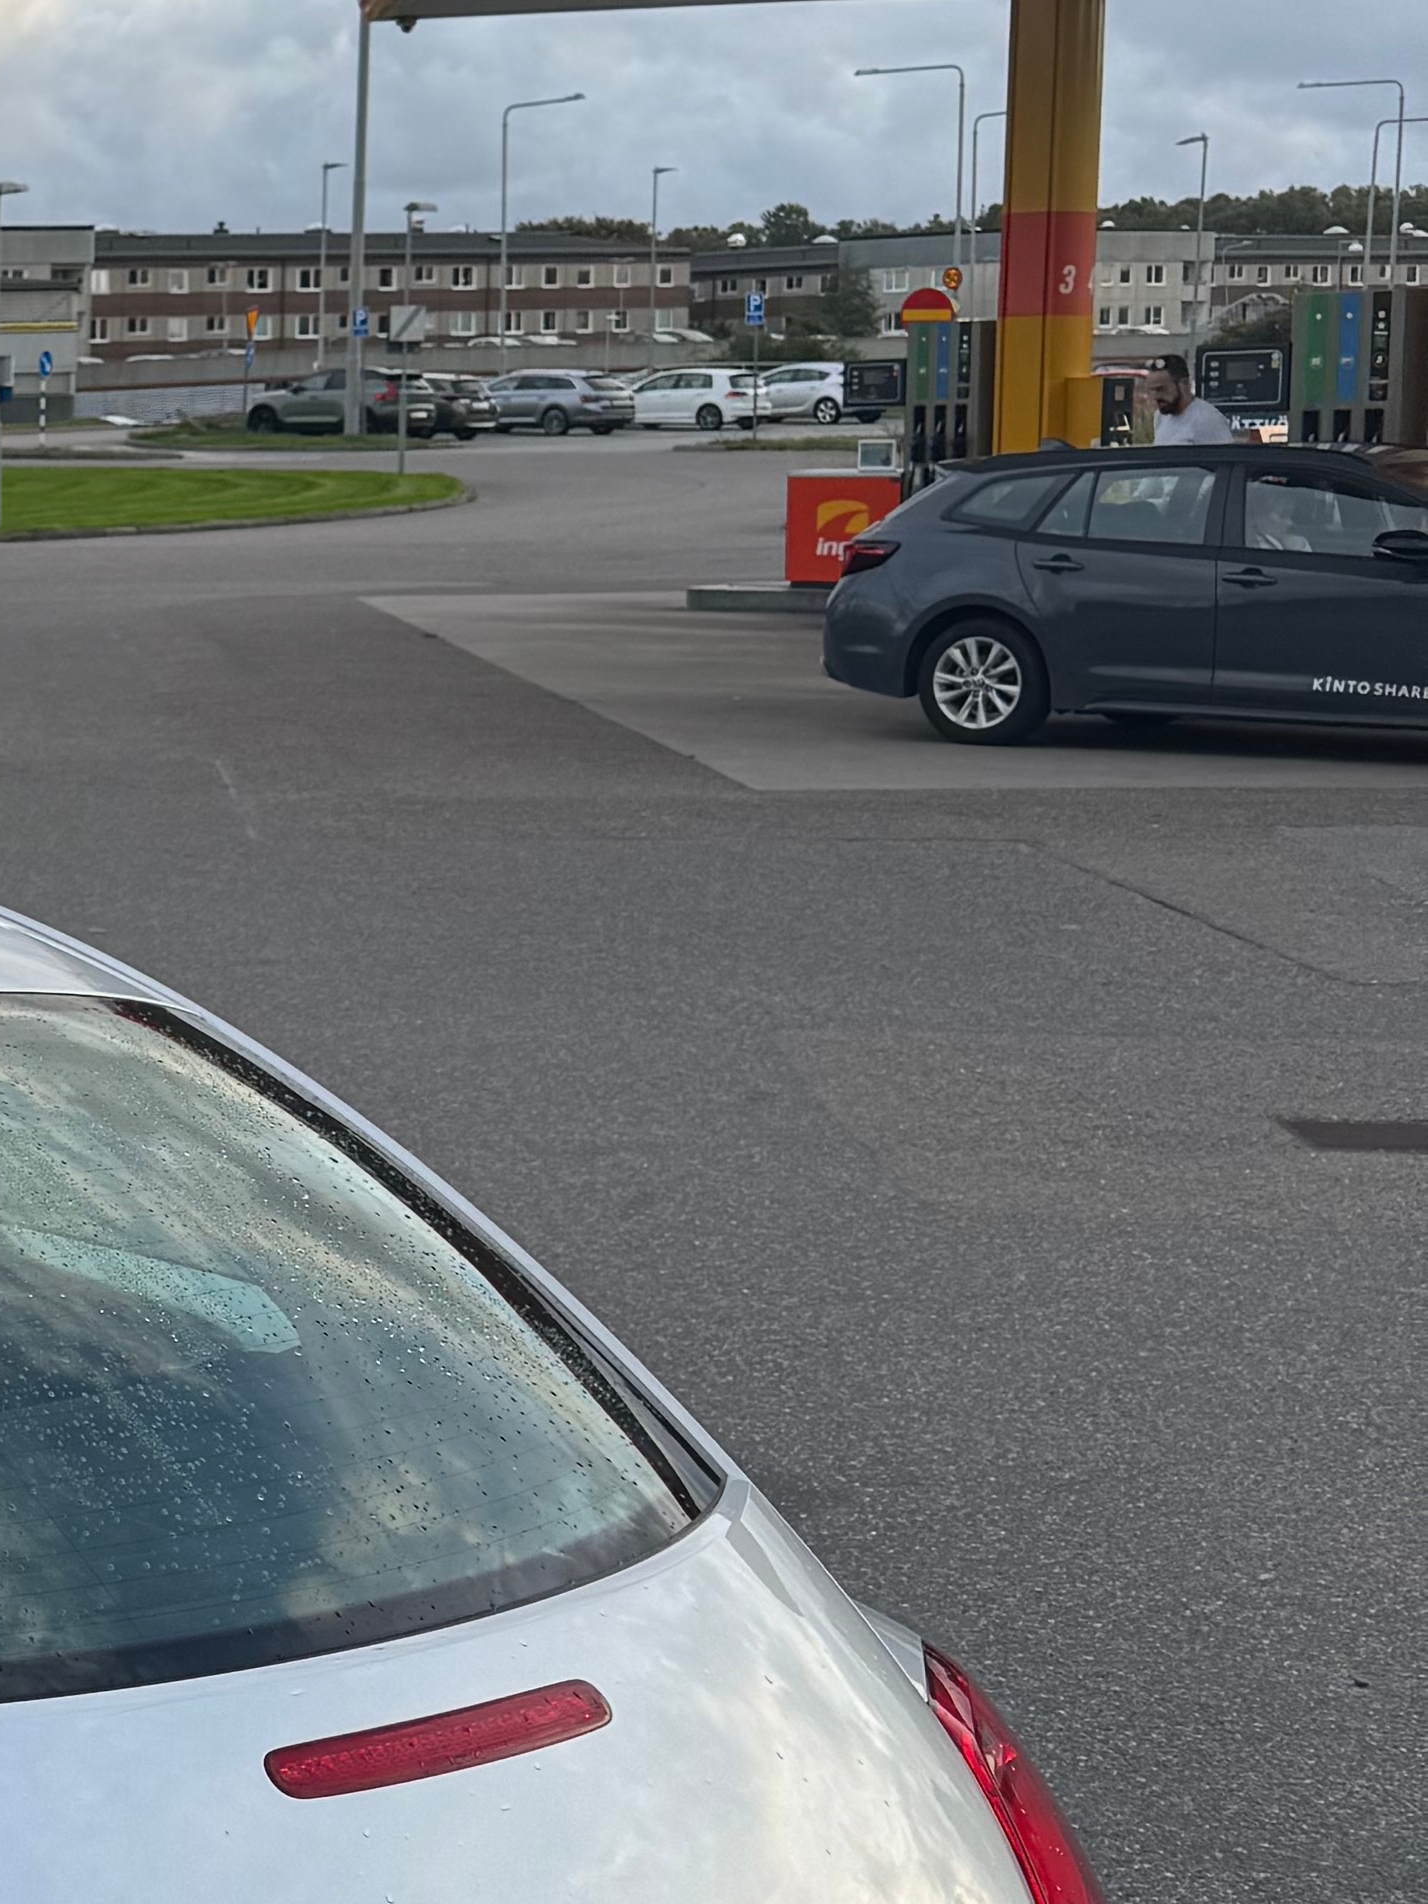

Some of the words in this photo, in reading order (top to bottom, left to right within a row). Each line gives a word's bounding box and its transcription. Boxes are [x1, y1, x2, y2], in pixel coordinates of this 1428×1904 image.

[1059, 265, 1076, 294] 3
[750, 294, 762, 312] P
[355, 311, 367, 328] P
